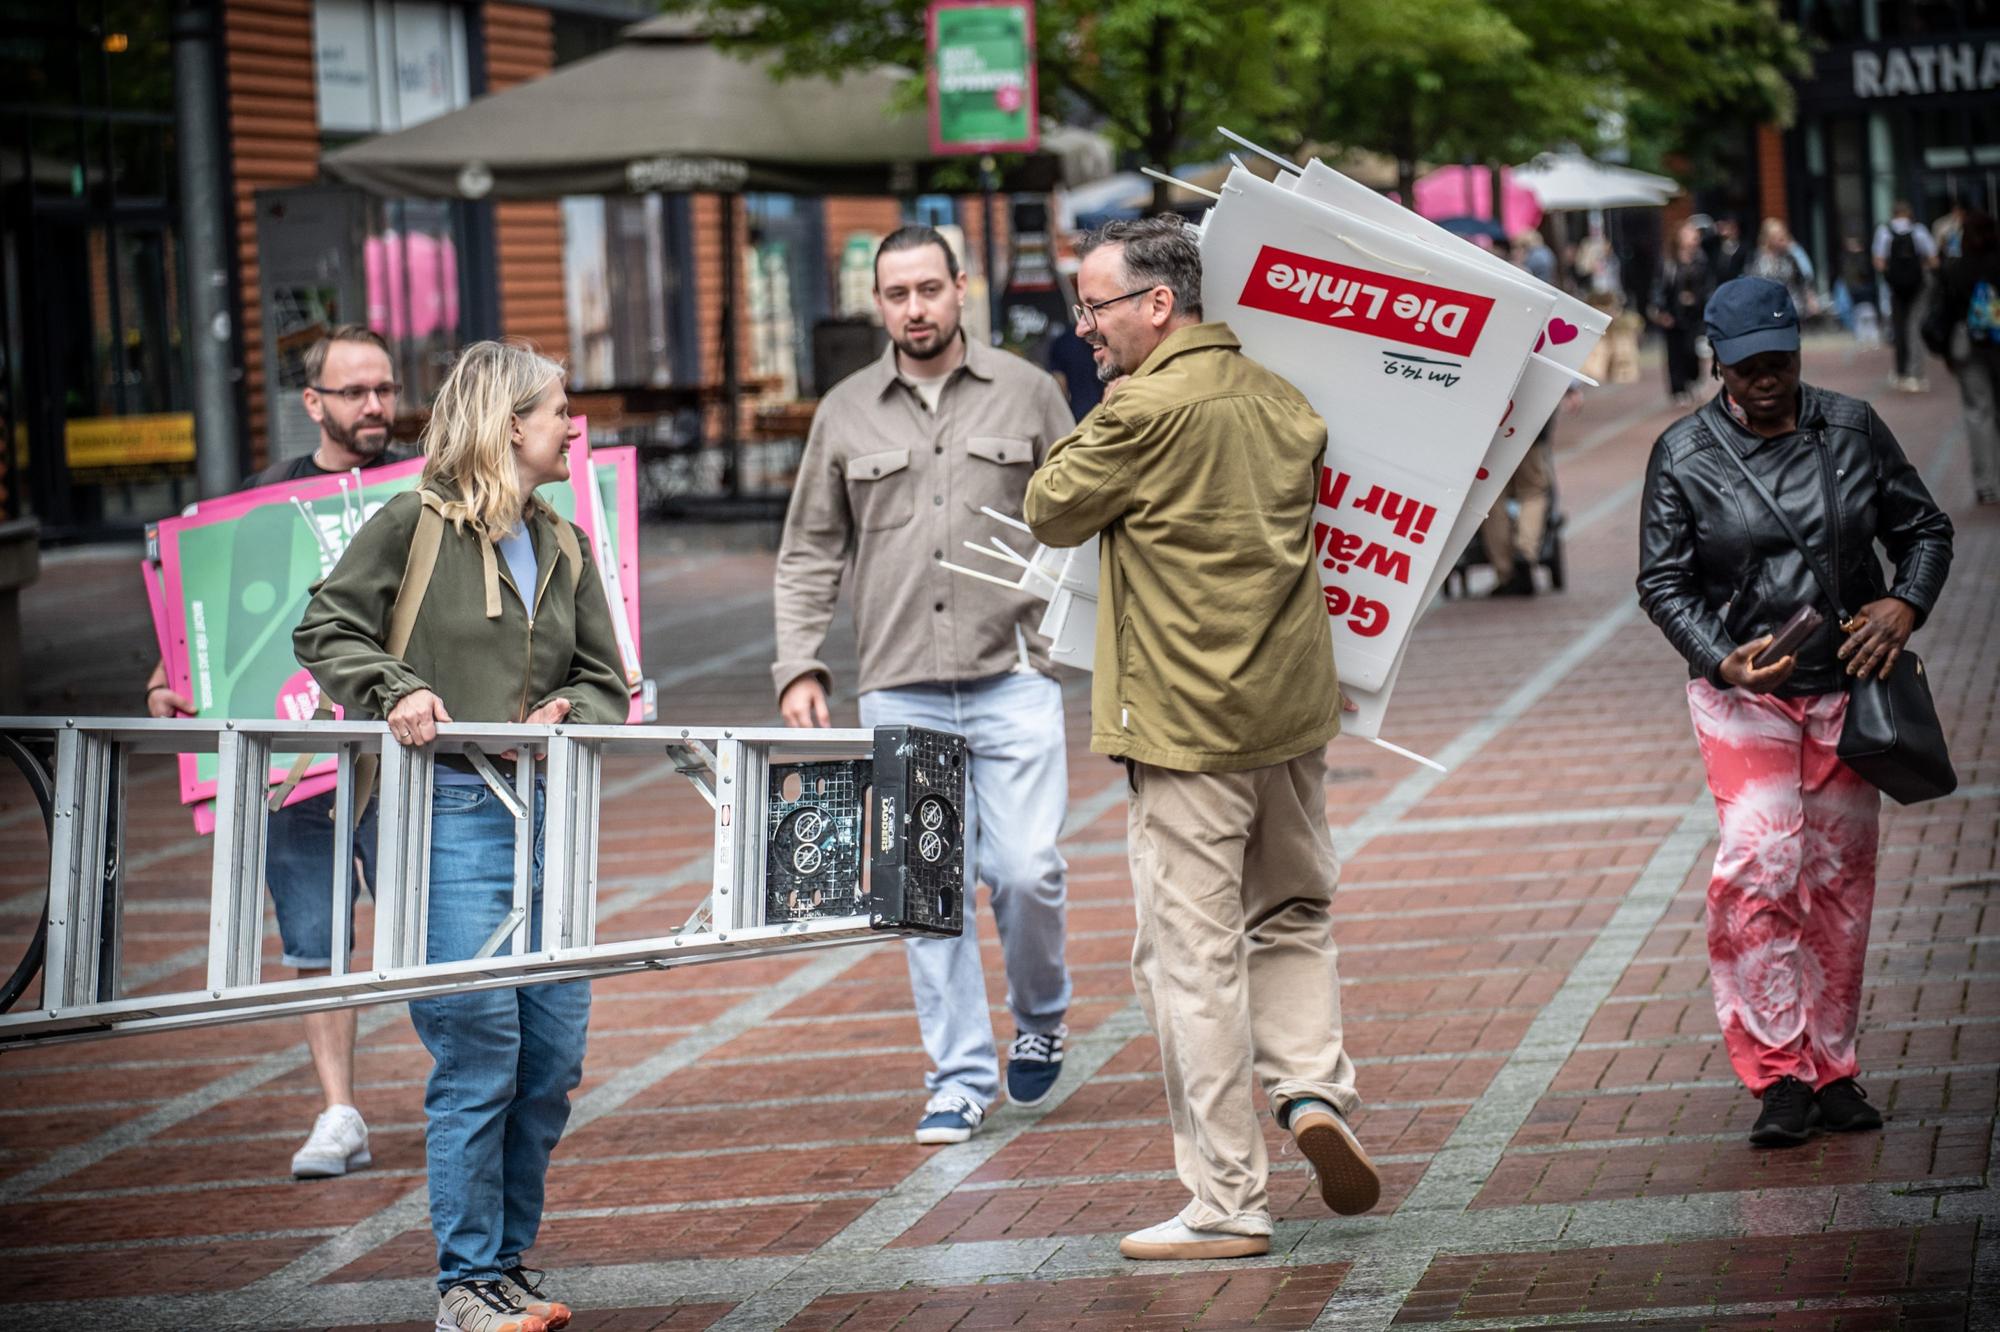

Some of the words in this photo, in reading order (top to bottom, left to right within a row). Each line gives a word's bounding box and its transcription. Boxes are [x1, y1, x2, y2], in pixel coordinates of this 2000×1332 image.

[1853, 42, 2000, 98] RATHA
[1266, 263, 1389, 320] Linke
[1392, 293, 1470, 338] Die
[1384, 361, 1422, 379] 14.9.
[1428, 371, 1461, 387] Am
[1352, 484, 1437, 544] ihr
[881, 798, 889, 852] LADDERS
